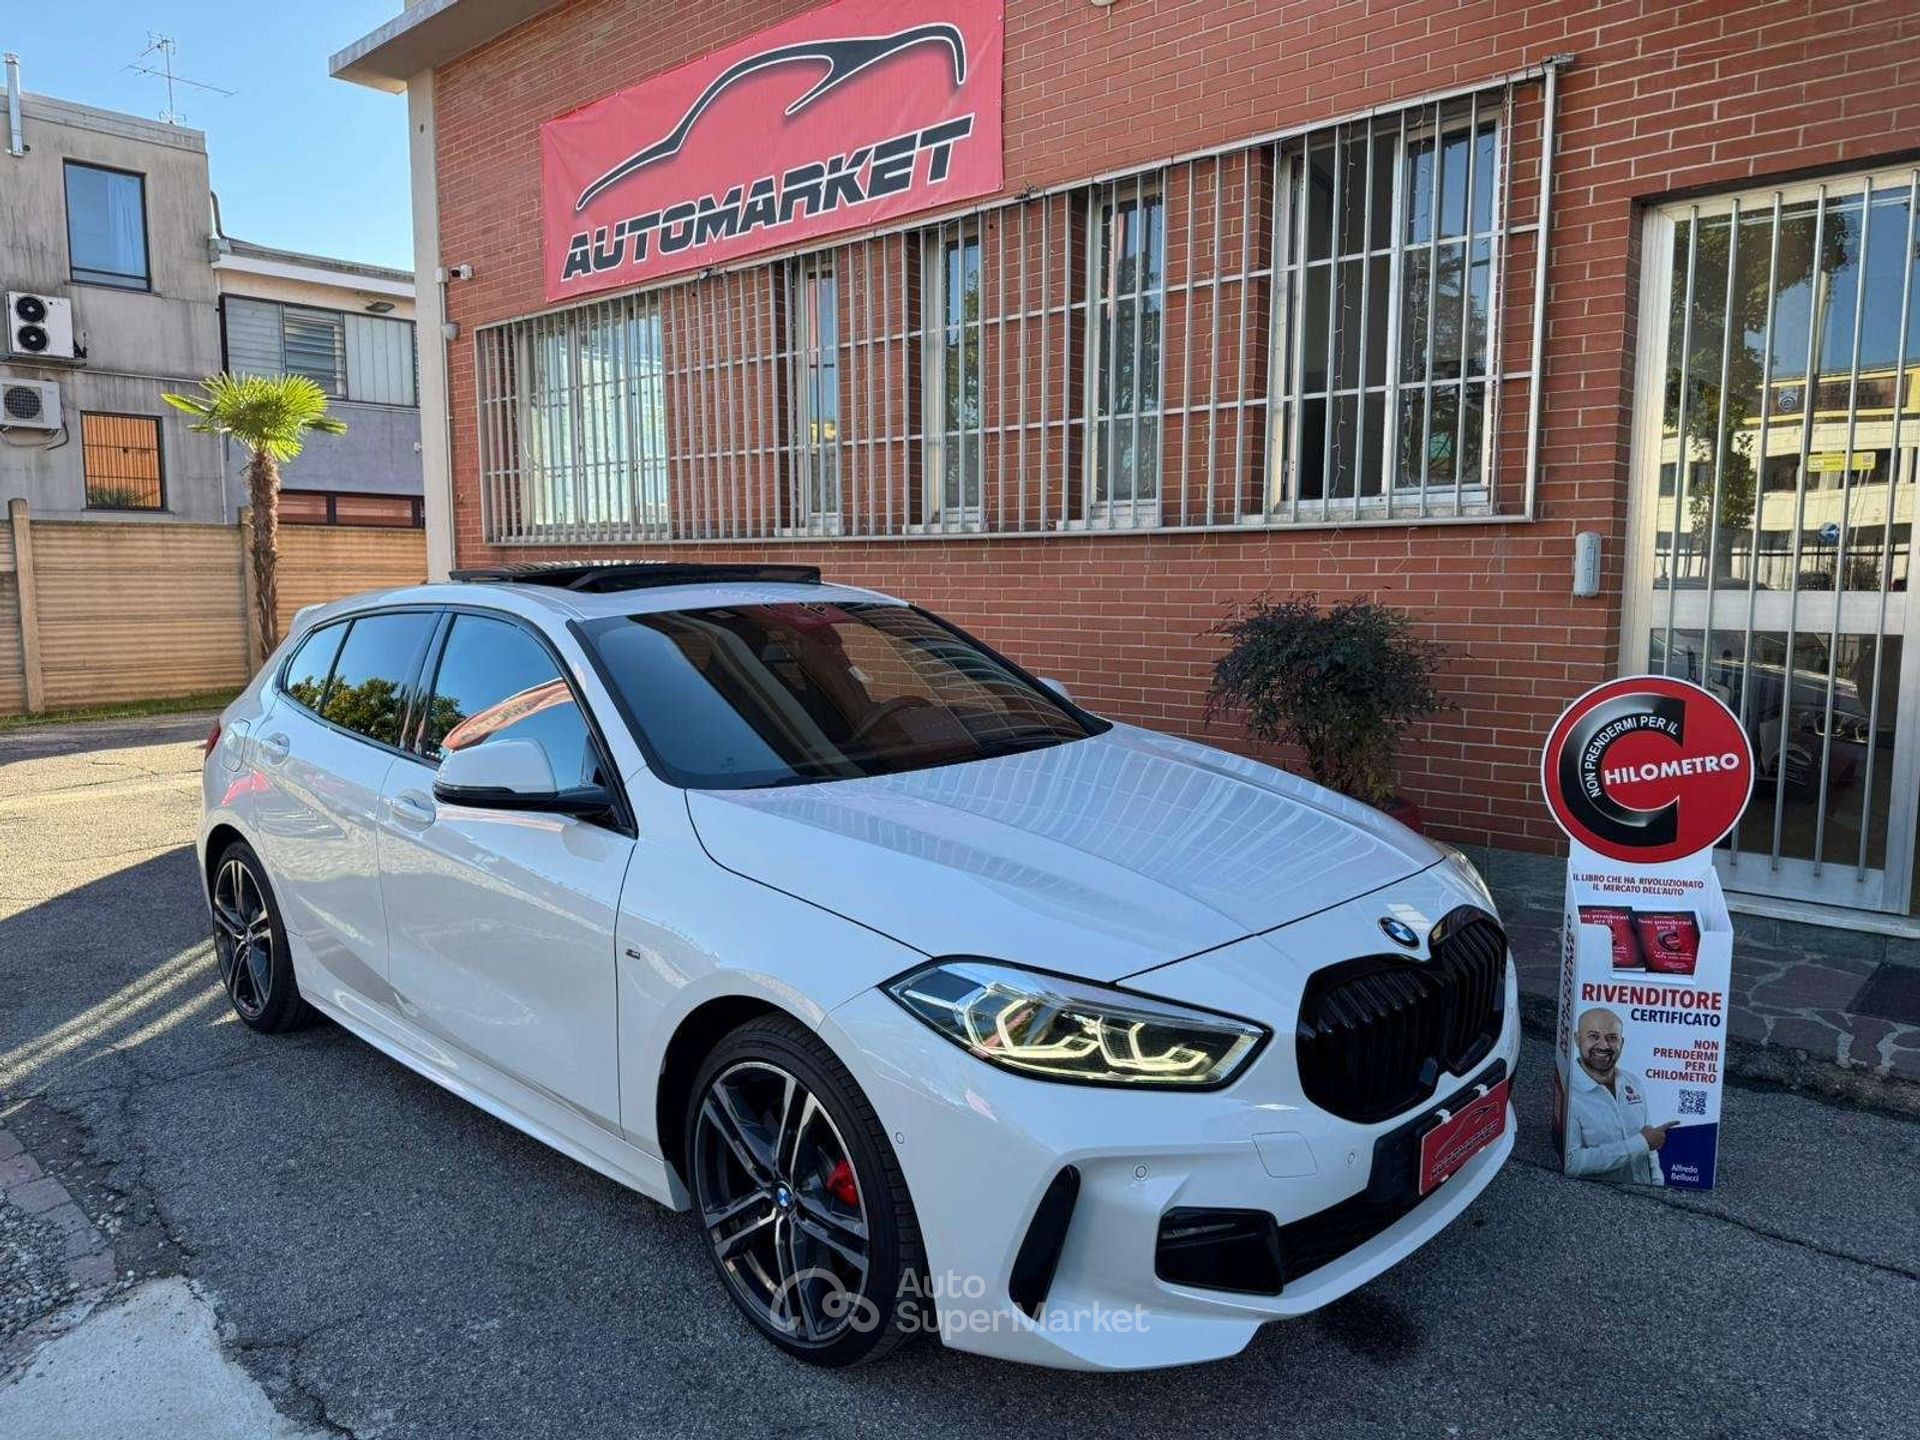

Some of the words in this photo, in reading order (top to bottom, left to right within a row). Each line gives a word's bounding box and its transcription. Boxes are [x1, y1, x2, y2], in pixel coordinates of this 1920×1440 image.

[561, 112, 975, 282] AUTOMARKET
[1640, 715, 1667, 730] PER
[1667, 721, 1679, 736] IL
[1584, 717, 1638, 770] PRENDERMI
[1584, 772, 1602, 798] NON
[1573, 873, 1581, 882] IL
[1581, 873, 1605, 883] LIBRO
[1606, 875, 1622, 884] CHE
[1623, 876, 1636, 885] HA
[1638, 877, 1705, 889] RIVOLUZIONATO
[1592, 883, 1600, 892] IL
[1603, 884, 1641, 894] MERCATO
[1642, 886, 1685, 897] DELL'AUTO
[1581, 982, 1722, 1011] RIVENDITORE
[1631, 1008, 1721, 1027] CERTIFICATO
[1694, 1039, 1719, 1051] NON
[1653, 1047, 1718, 1062] PRENDERMI
[1685, 1060, 1706, 1072] PER
[1708, 1062, 1718, 1073] IL
[1645, 1068, 1717, 1084] CHILOMETRO
